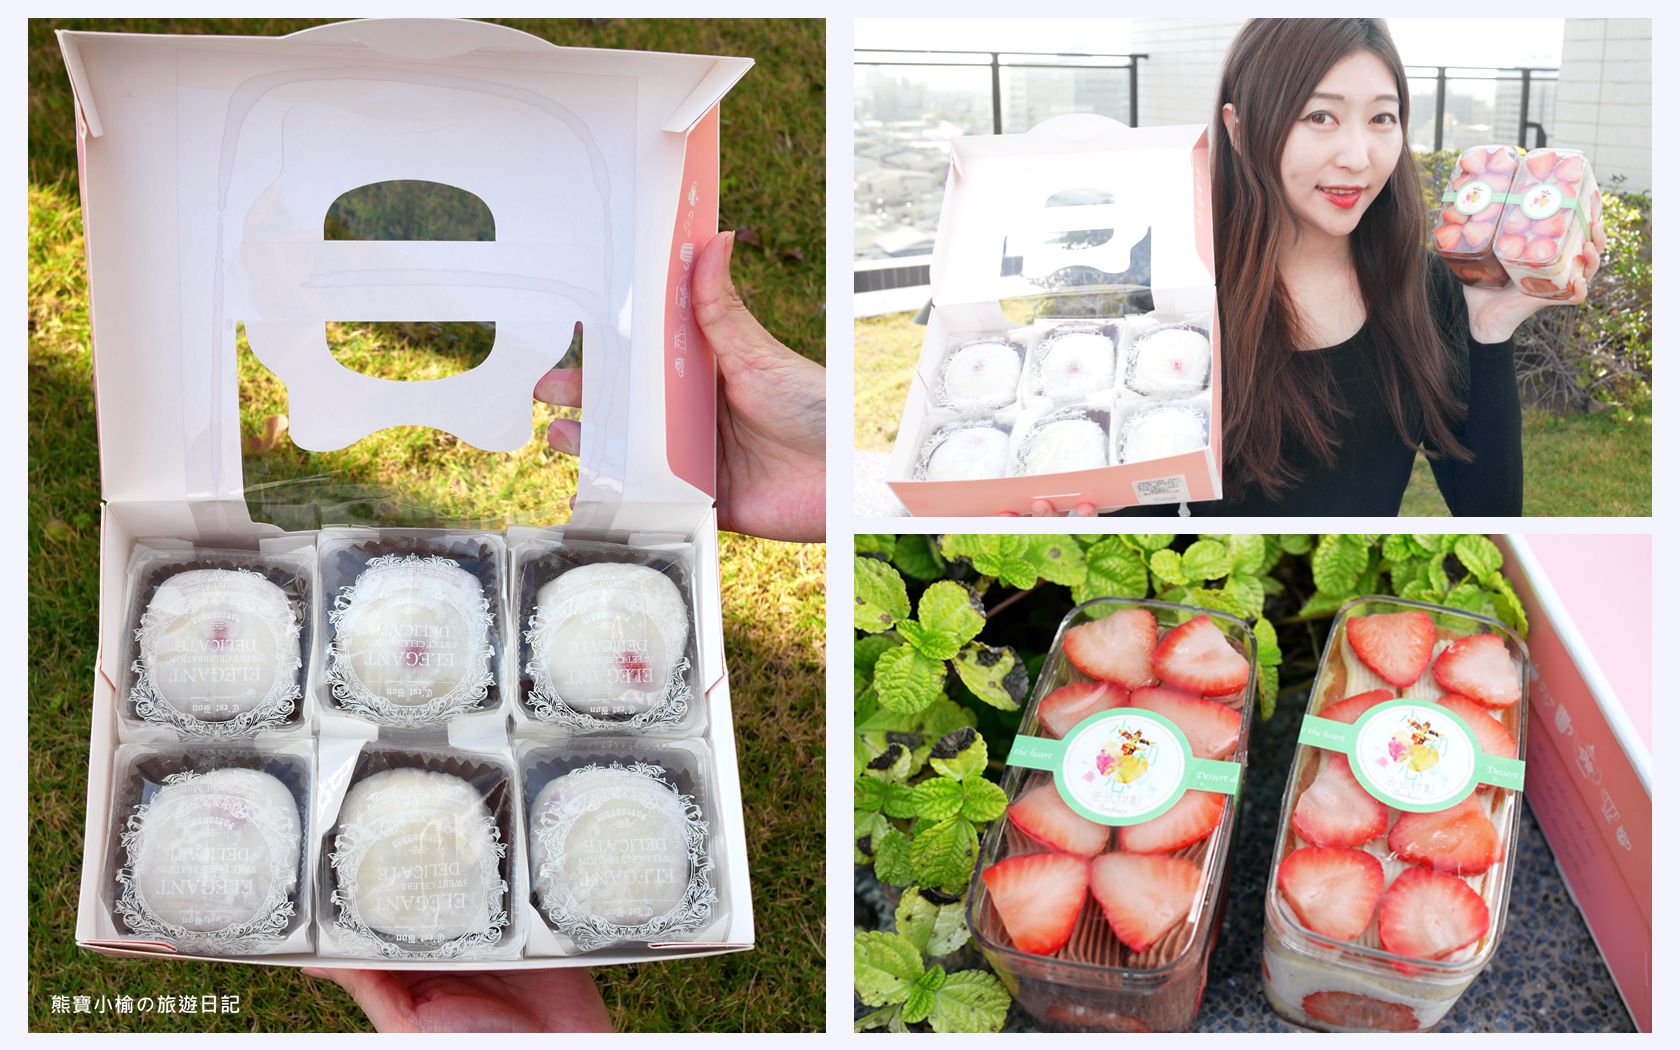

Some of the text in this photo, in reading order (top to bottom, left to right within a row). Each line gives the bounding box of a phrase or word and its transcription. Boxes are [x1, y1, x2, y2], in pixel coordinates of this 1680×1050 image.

[174, 639, 256, 652] DELICATE
[364, 652, 454, 667] ELEGANT
[168, 667, 260, 682] ELEGANT
[566, 668, 653, 684] ELEGANT
[1196, 771, 1229, 782] Dessert
[1487, 766, 1519, 779] Dessert
[582, 837, 667, 853] DELICATE
[376, 862, 460, 880] DELICATE
[579, 868, 674, 885] ELEGANT
[156, 879, 254, 895] ELEGANT
[438, 879, 469, 889] SWEET
[372, 892, 466, 911] ELEGANT
